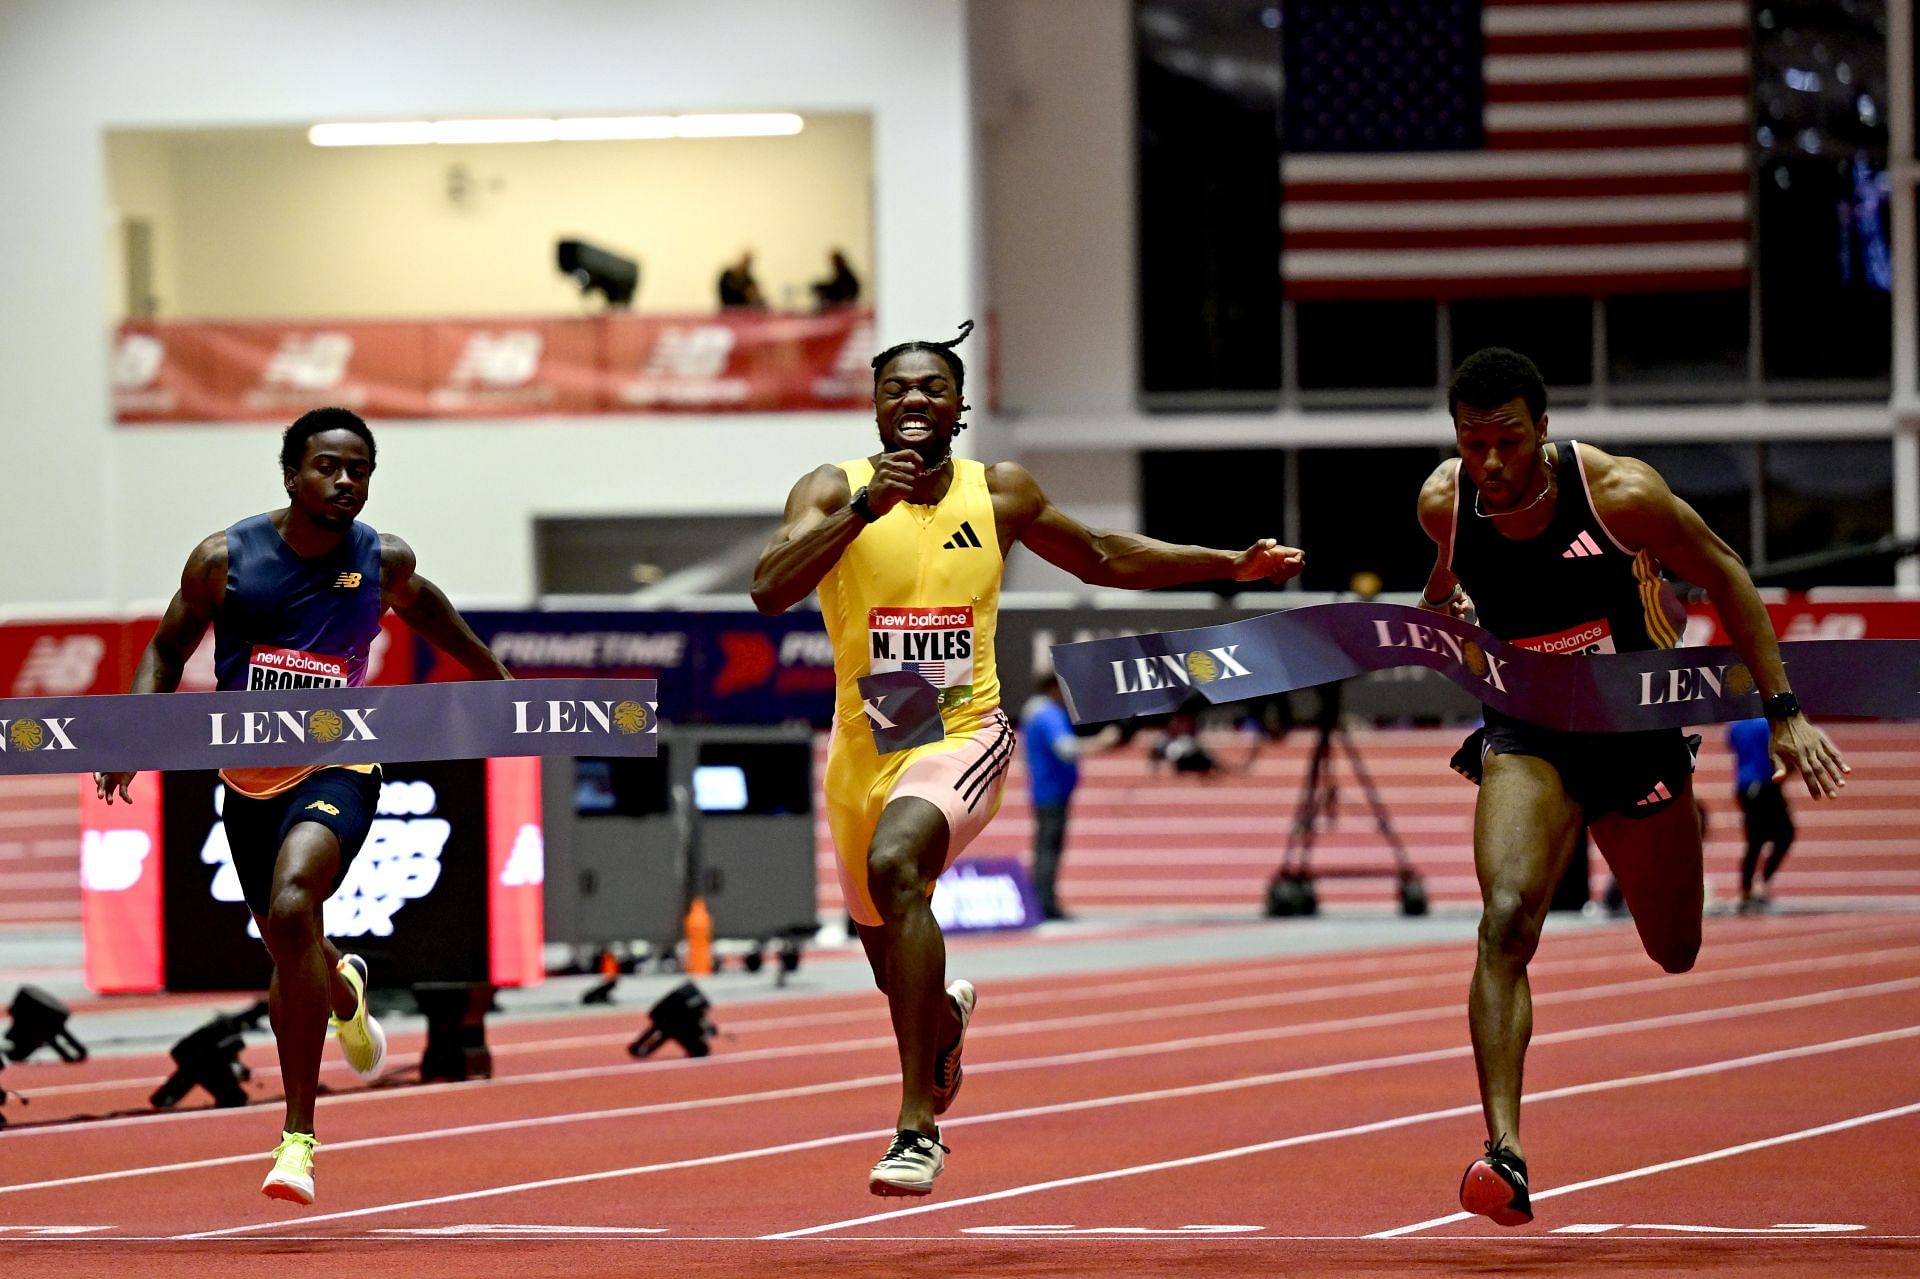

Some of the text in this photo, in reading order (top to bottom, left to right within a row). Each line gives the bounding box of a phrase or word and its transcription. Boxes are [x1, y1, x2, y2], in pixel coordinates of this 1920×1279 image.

[875, 613, 967, 627] new balance
[872, 632, 896, 660] N.
[903, 630, 971, 661] LYLES
[1543, 624, 1602, 653] balance
[256, 652, 341, 674] new balance
[1109, 645, 1253, 695] LENOX
[1372, 619, 1509, 694] LENOX
[208, 708, 379, 746] LENOX
